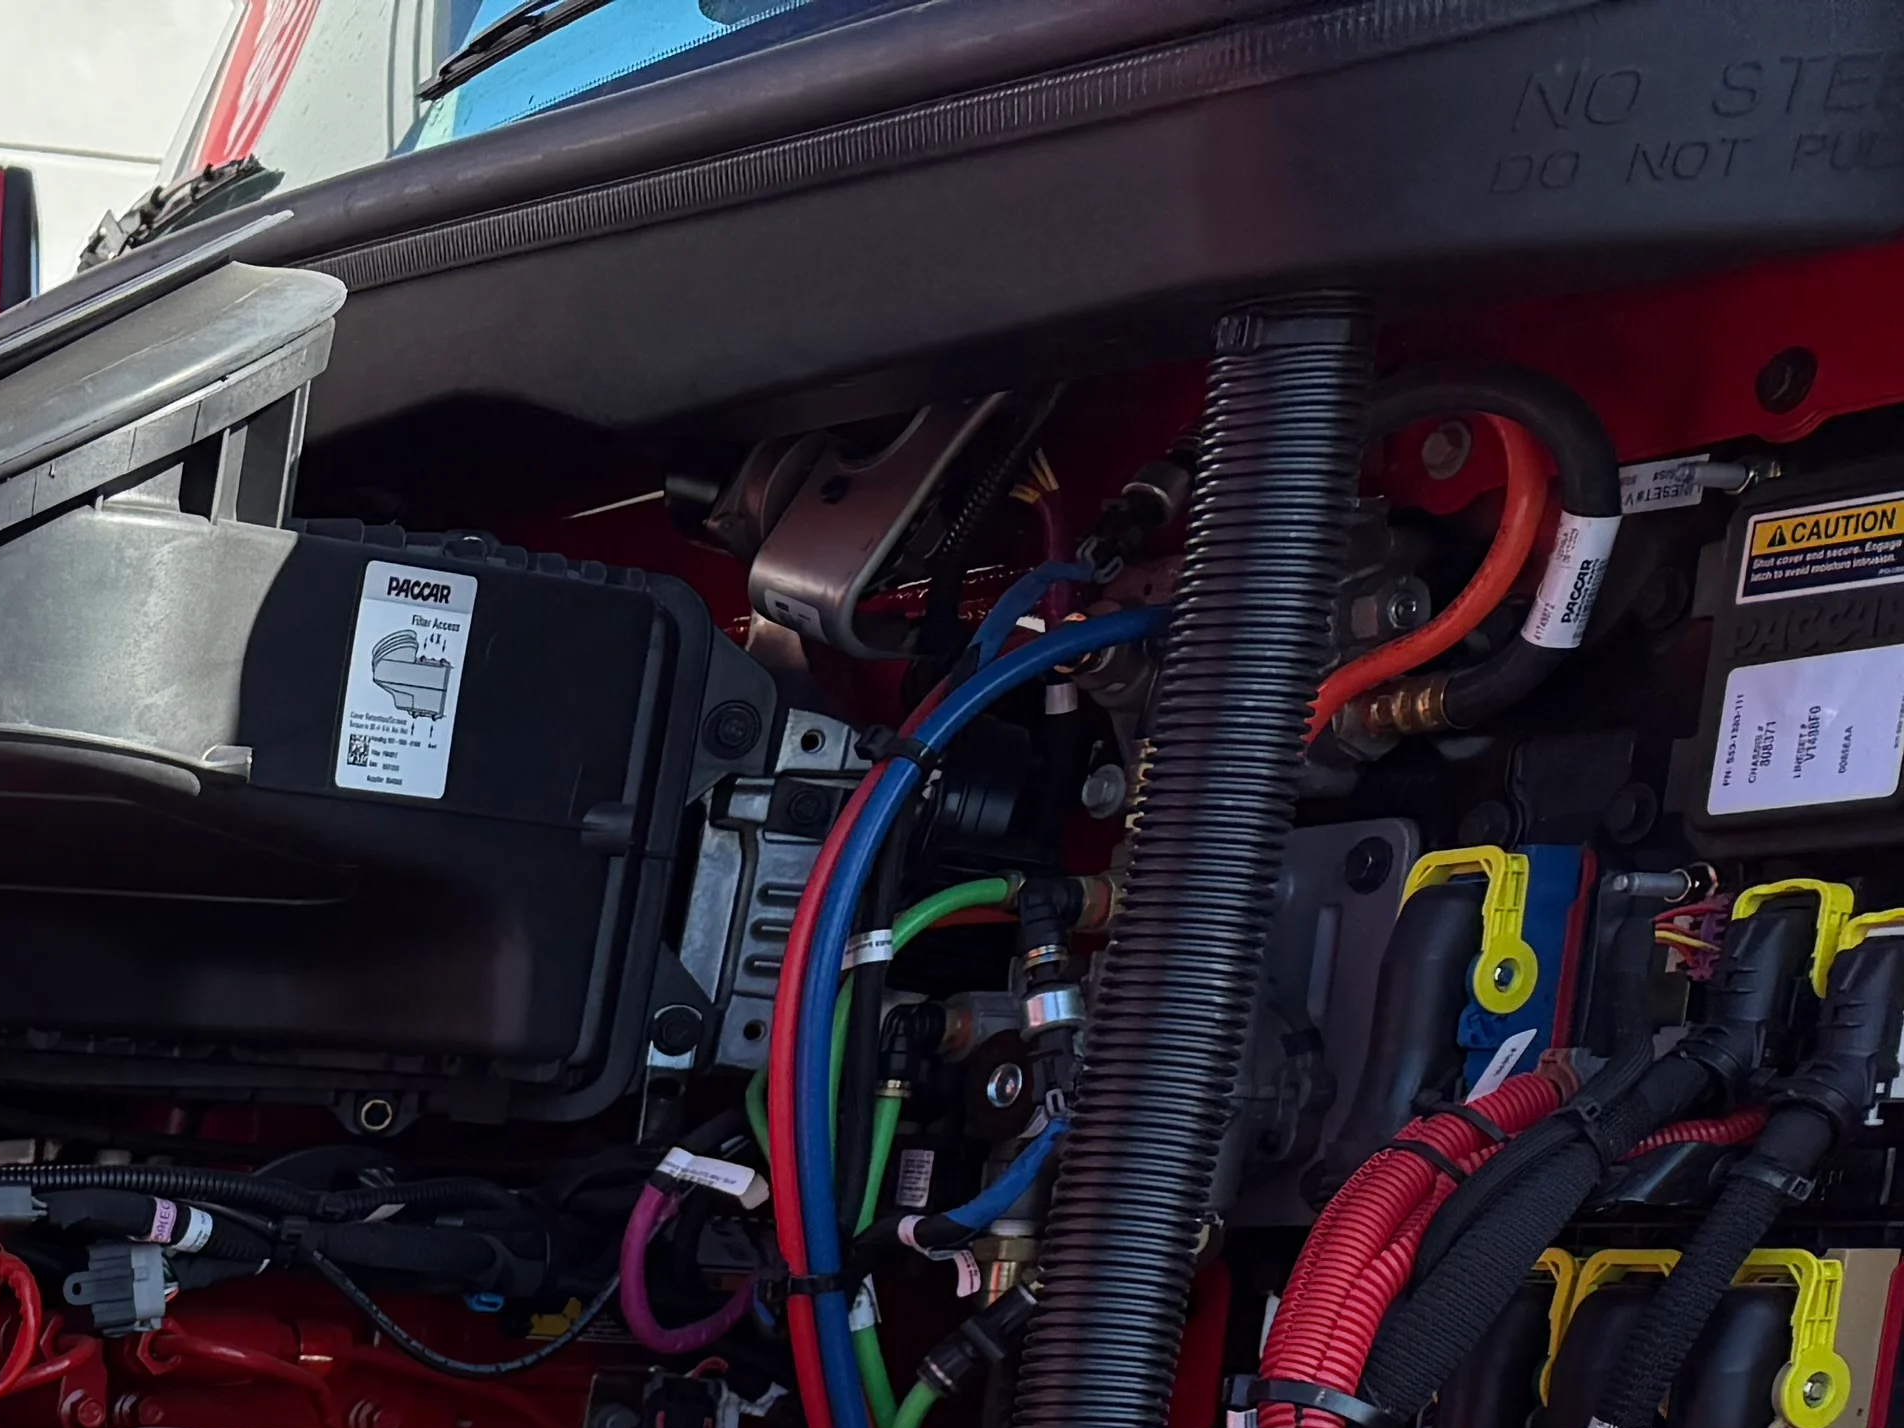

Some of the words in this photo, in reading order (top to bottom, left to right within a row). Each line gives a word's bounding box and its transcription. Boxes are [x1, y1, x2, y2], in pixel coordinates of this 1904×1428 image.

[1511, 70, 1641, 133] NO
[1712, 52, 1900, 118] STE
[1490, 150, 1580, 194] DO
[1626, 138, 1752, 185] NOT
[1789, 507, 1898, 543] CAUTION
[1805, 549, 1825, 560] and
[386, 576, 452, 605] PACCAR
[1560, 556, 1593, 625] PACCAR
[411, 614, 431, 629] Filter
[432, 617, 460, 633] Access
